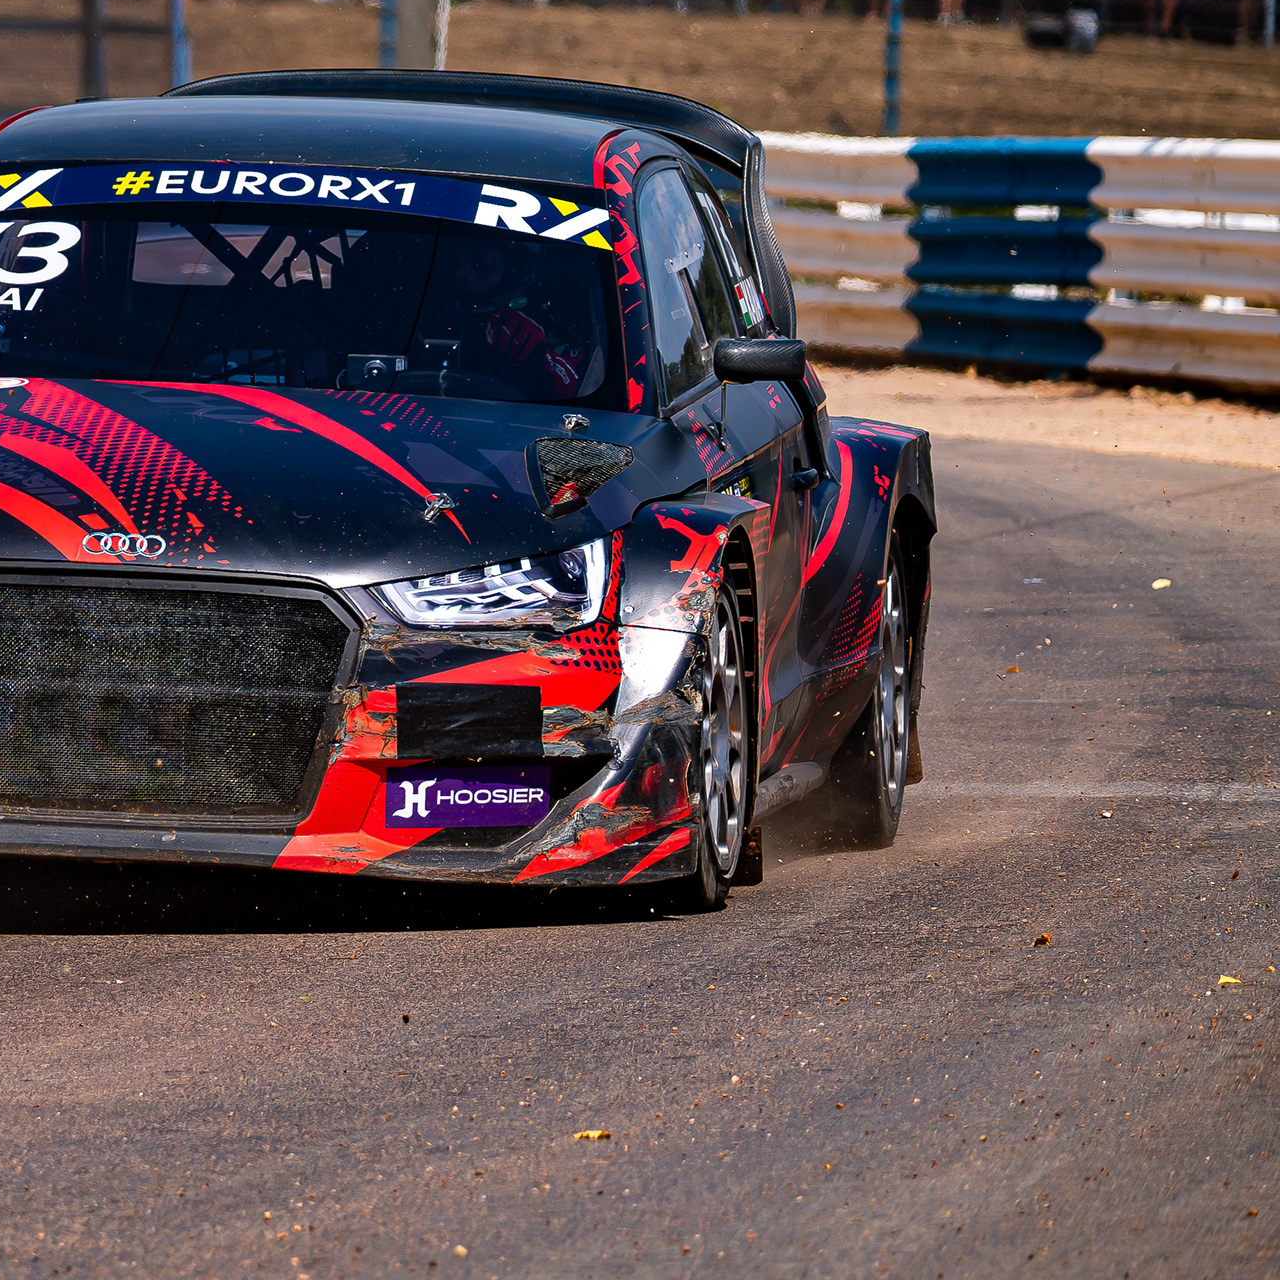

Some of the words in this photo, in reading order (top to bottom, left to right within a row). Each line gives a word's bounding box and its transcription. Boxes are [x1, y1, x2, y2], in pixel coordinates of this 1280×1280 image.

[112, 170, 416, 206] #EURORX1
[474, 184, 613, 251] RX
[436, 788, 544, 805] HOOSIER
